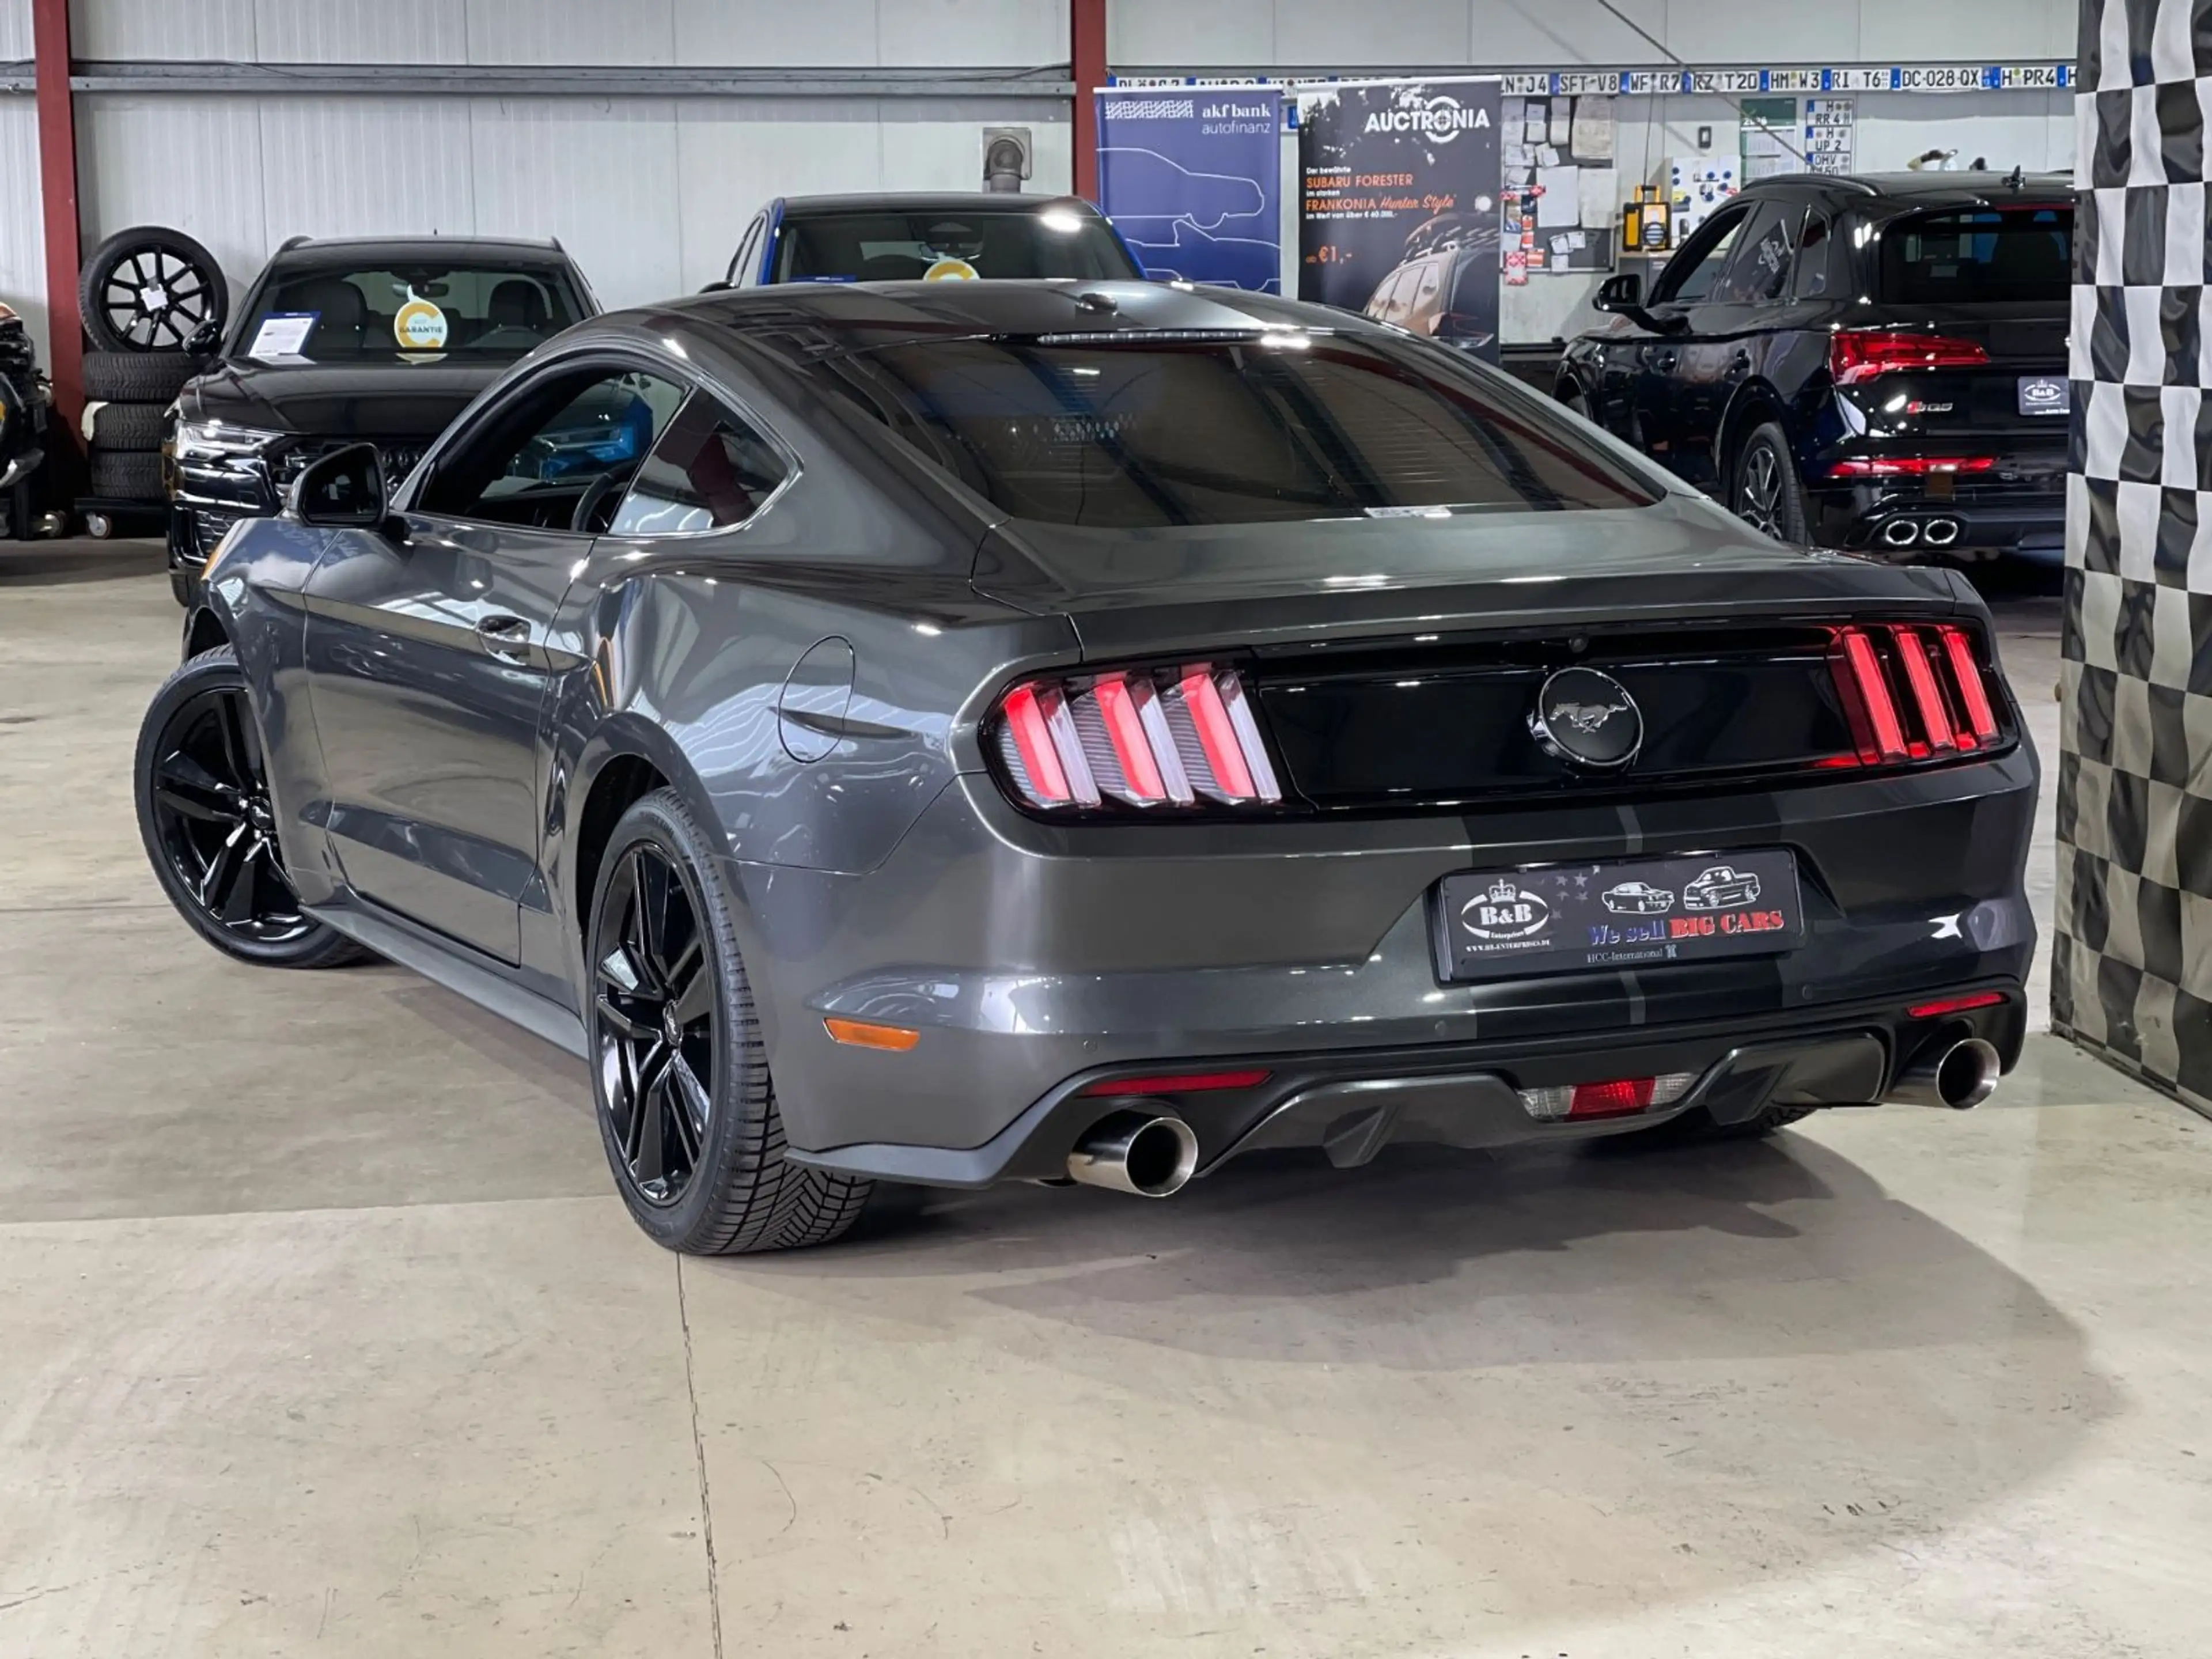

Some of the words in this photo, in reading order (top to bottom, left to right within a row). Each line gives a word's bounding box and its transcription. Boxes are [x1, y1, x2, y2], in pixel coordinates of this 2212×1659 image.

[1500, 77, 1515, 93] N
[1560, 75, 1588, 92] SFT
[1597, 75, 1618, 92] V8
[1631, 75, 1649, 90] WF
[1660, 74, 1679, 90] R7
[1725, 73, 1757, 89] T20
[1771, 72, 1789, 89] HM
[1833, 71, 1850, 88] RI
[1863, 71, 1881, 88] T6
[2002, 70, 2012, 86] H
[2023, 69, 2055, 85] PR4
[1202, 103, 1230, 118] akf
[1231, 103, 1271, 118] bank
[1826, 100, 1834, 112] H
[1202, 120, 1271, 134] autofinanz
[1364, 108, 1491, 133] AUCTRONIA
[1826, 127, 1834, 139] H
[1306, 175, 1351, 188] SUBARU
[1355, 173, 1414, 187] FORESTER
[1306, 198, 1377, 212] FRANKONIA
[1479, 903, 1533, 926] B&B
[1490, 930, 1524, 940] Enterprises
[1588, 924, 1620, 946] We
[1625, 919, 1666, 943] sell
[1669, 915, 1715, 939] BIG
[1720, 910, 1785, 934] CARS
[1587, 948, 1663, 964] HCC-International
